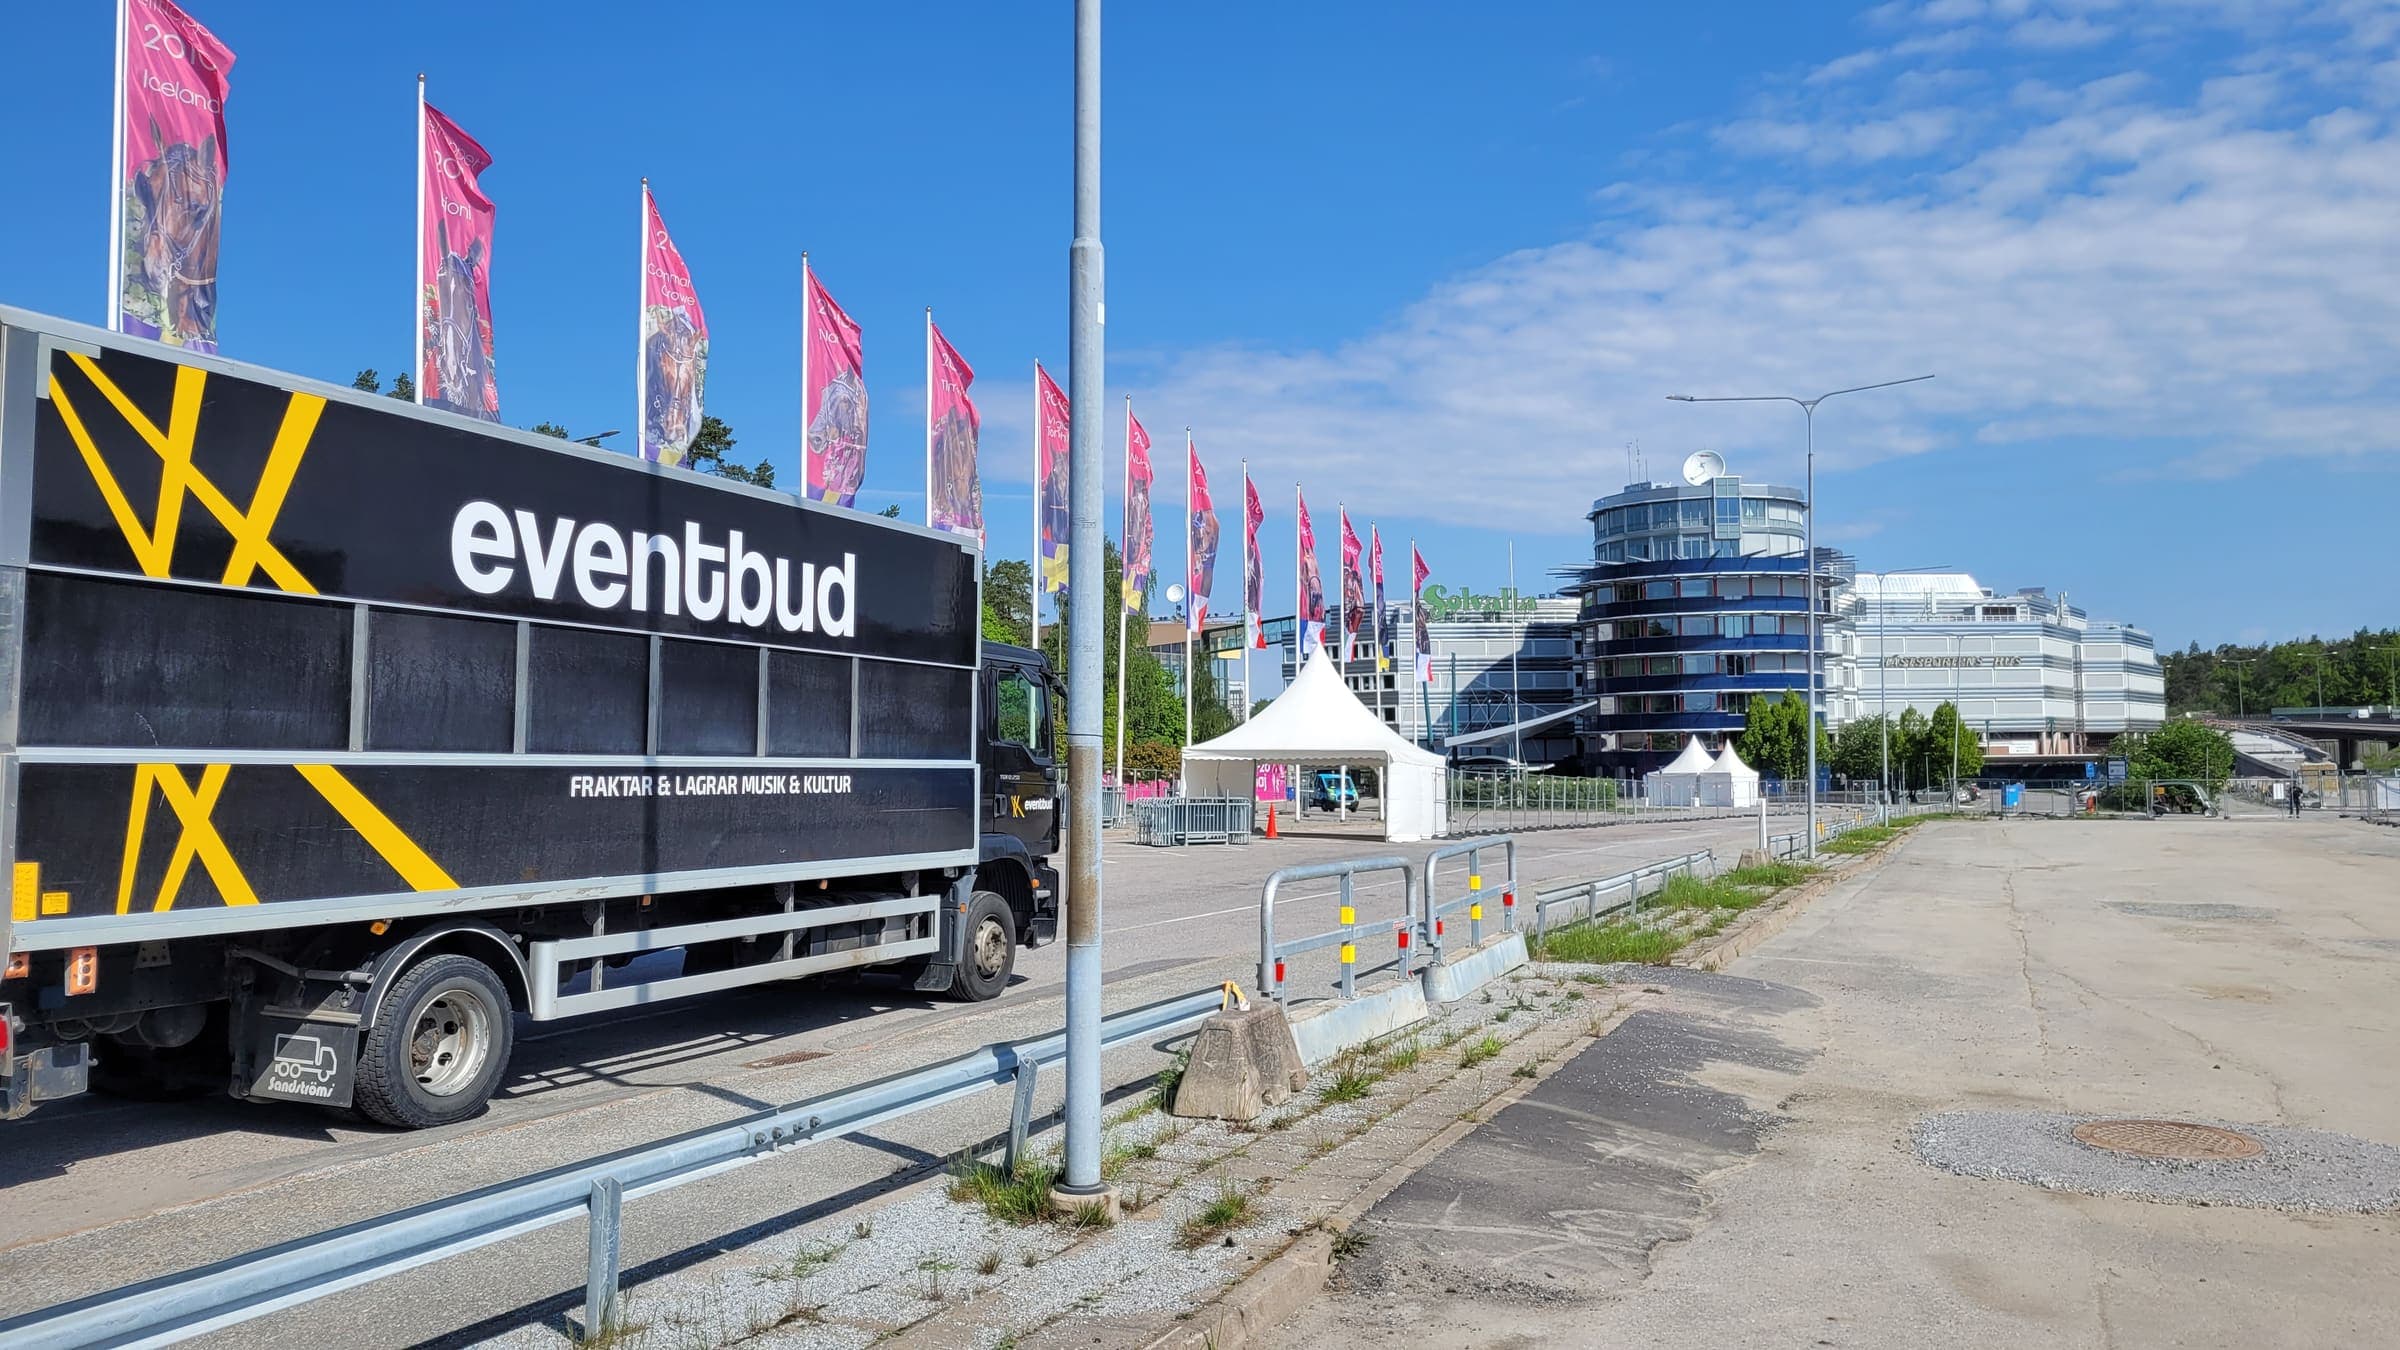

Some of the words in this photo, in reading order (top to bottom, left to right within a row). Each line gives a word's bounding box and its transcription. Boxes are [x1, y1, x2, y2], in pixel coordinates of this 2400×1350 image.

[142, 68, 221, 114] Iceland
[451, 501, 856, 638] eventbud
[1423, 584, 1537, 619] Solvalla
[570, 776, 652, 797] FRAKTAR
[657, 776, 671, 796] &
[675, 775, 738, 796] LAGRAR
[741, 775, 786, 795] MUSIK
[789, 775, 801, 795] &
[803, 775, 852, 794] KULTUR
[1024, 797, 1053, 811] eventbud
[267, 1076, 336, 1098] Sandströms
